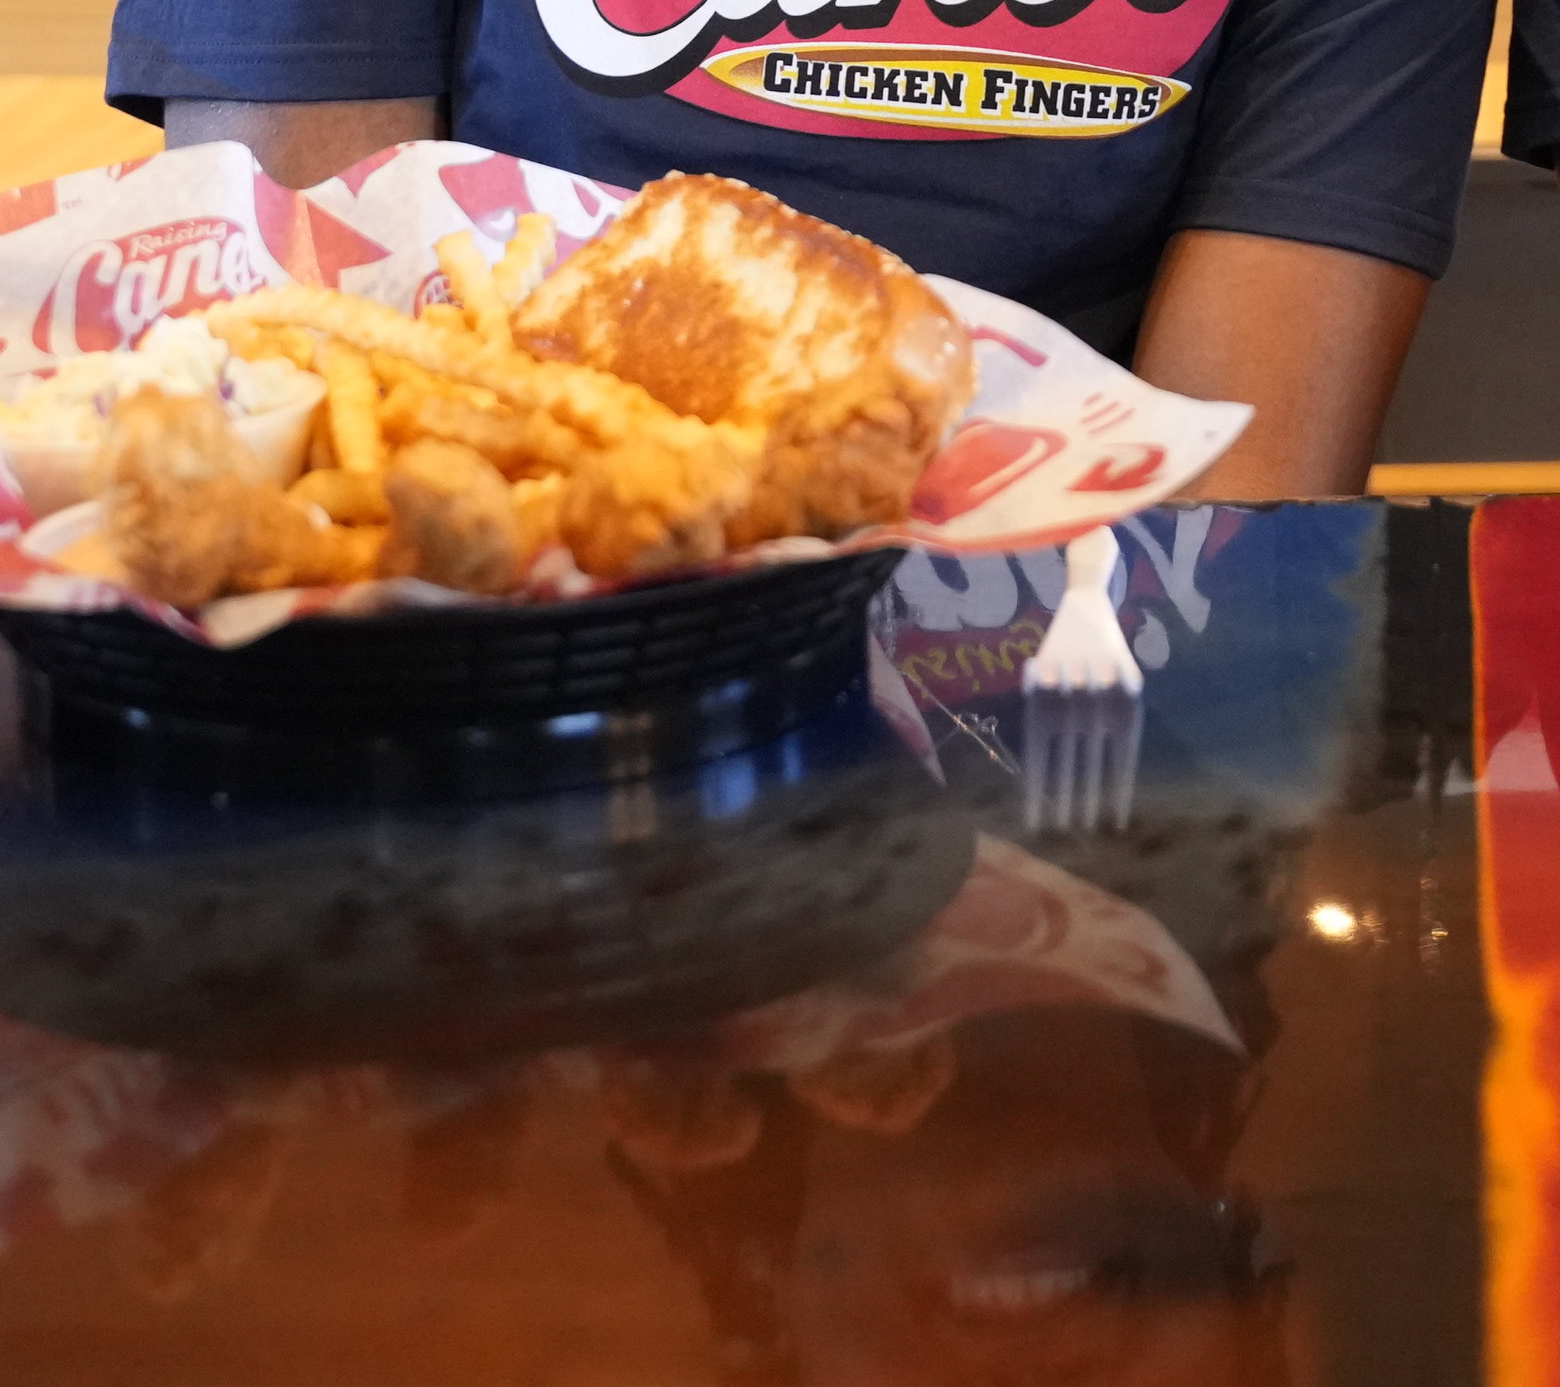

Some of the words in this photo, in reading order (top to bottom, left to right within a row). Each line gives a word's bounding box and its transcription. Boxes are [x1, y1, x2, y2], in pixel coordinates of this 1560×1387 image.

[763, 51, 966, 115] CHICKEN
[980, 68, 1161, 120] FINGERS
[129, 221, 228, 259] Raising
